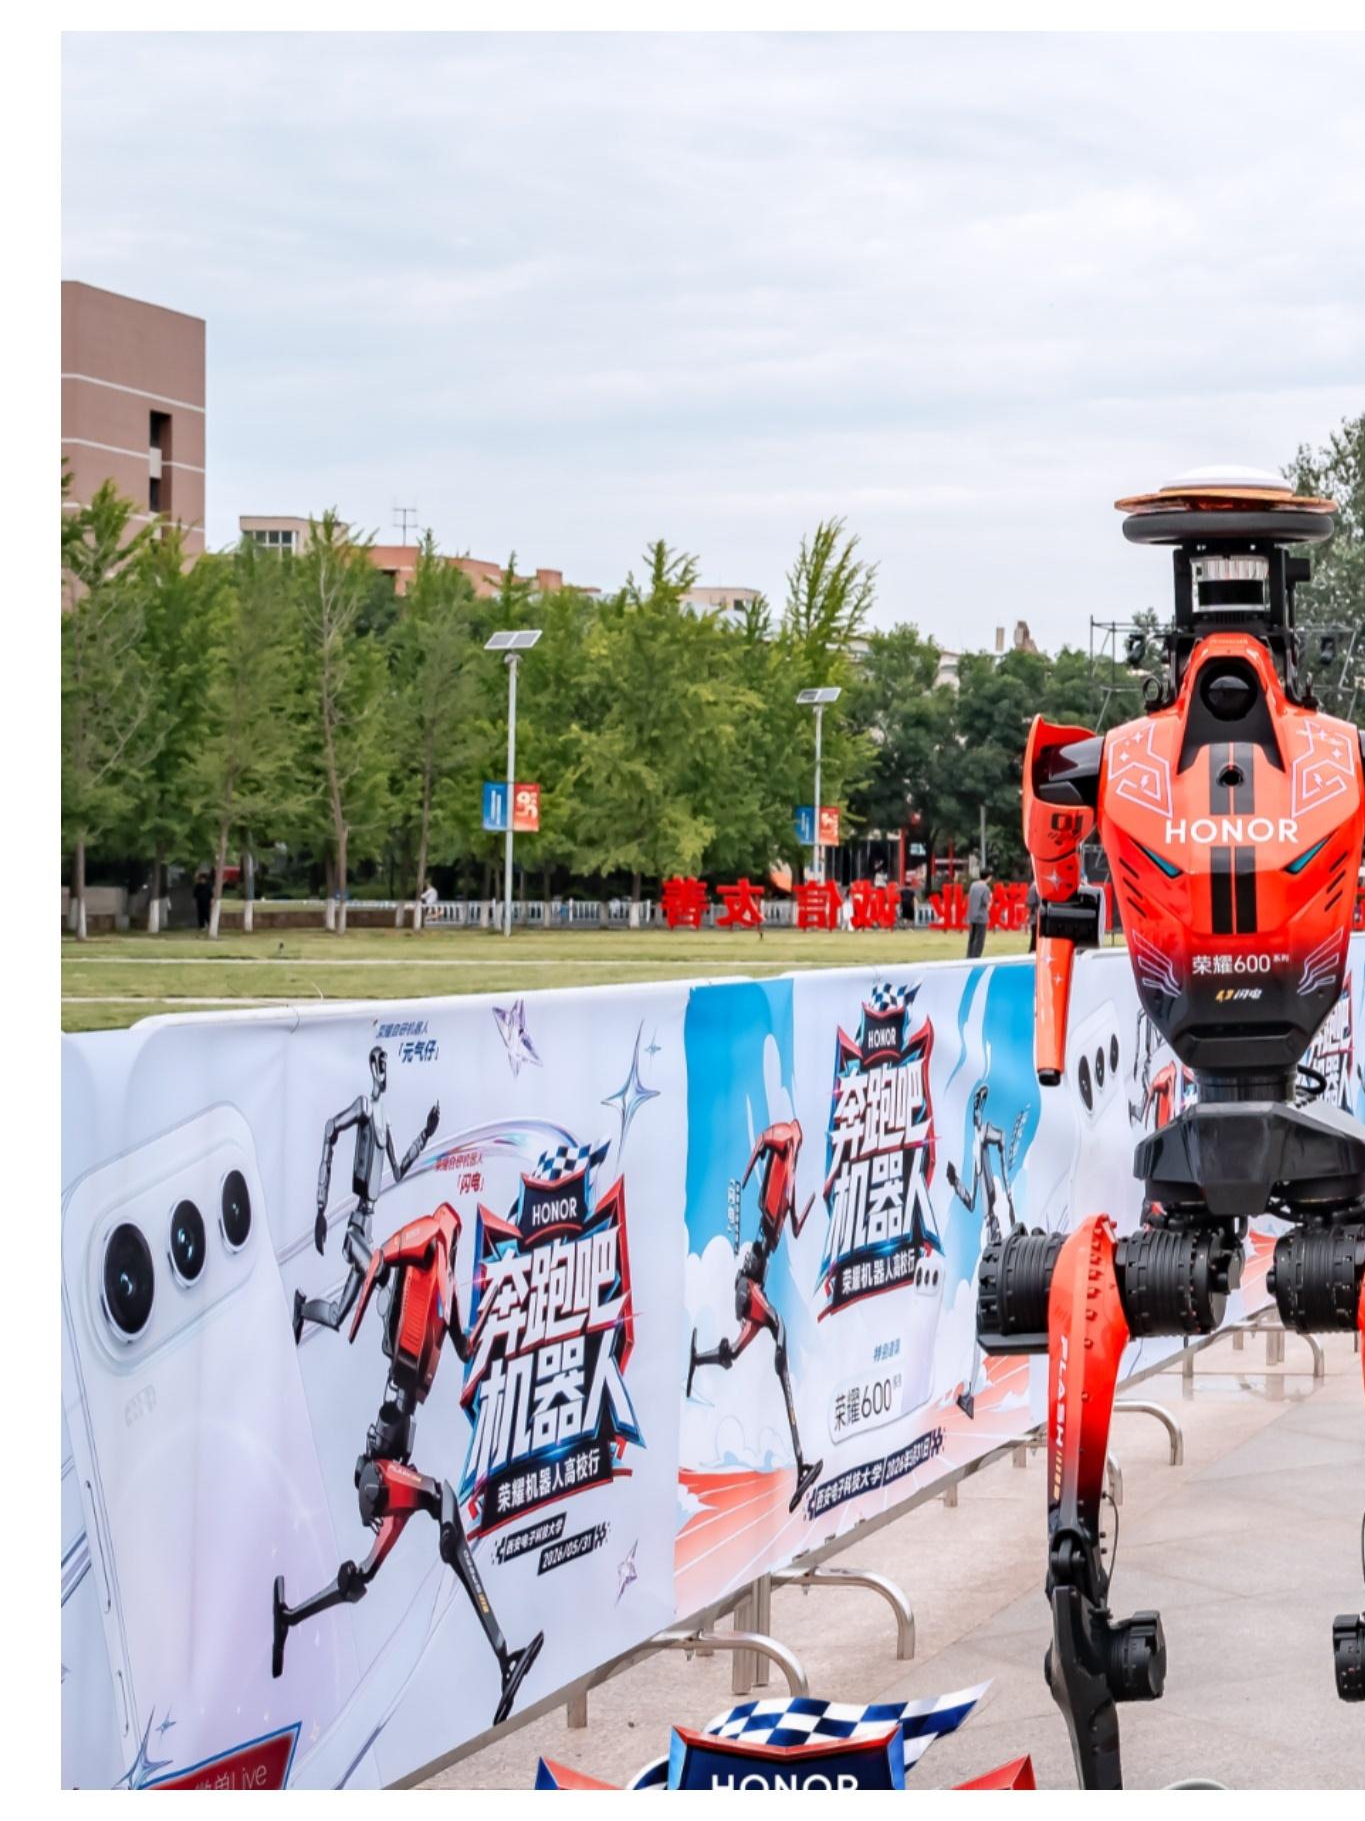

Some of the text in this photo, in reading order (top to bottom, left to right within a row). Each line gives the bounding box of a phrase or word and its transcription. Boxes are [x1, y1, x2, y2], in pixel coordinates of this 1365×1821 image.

[1165, 818, 1298, 845] HONOR
[1191, 954, 1271, 975] 荣耀600
[867, 1026, 897, 1049] HONOR
[825, 1058, 932, 1183] 奔跑吧
[532, 1196, 578, 1226] HONOR
[826, 1146, 939, 1262] 机器人
[467, 1223, 632, 1387] 奔跑吧
[465, 1328, 637, 1479] 机器人
[834, 1378, 893, 1432] 荣耀600
[1055, 1334, 1068, 1449] FLASH
[497, 1447, 601, 1513] 荣耀机器人高校行
